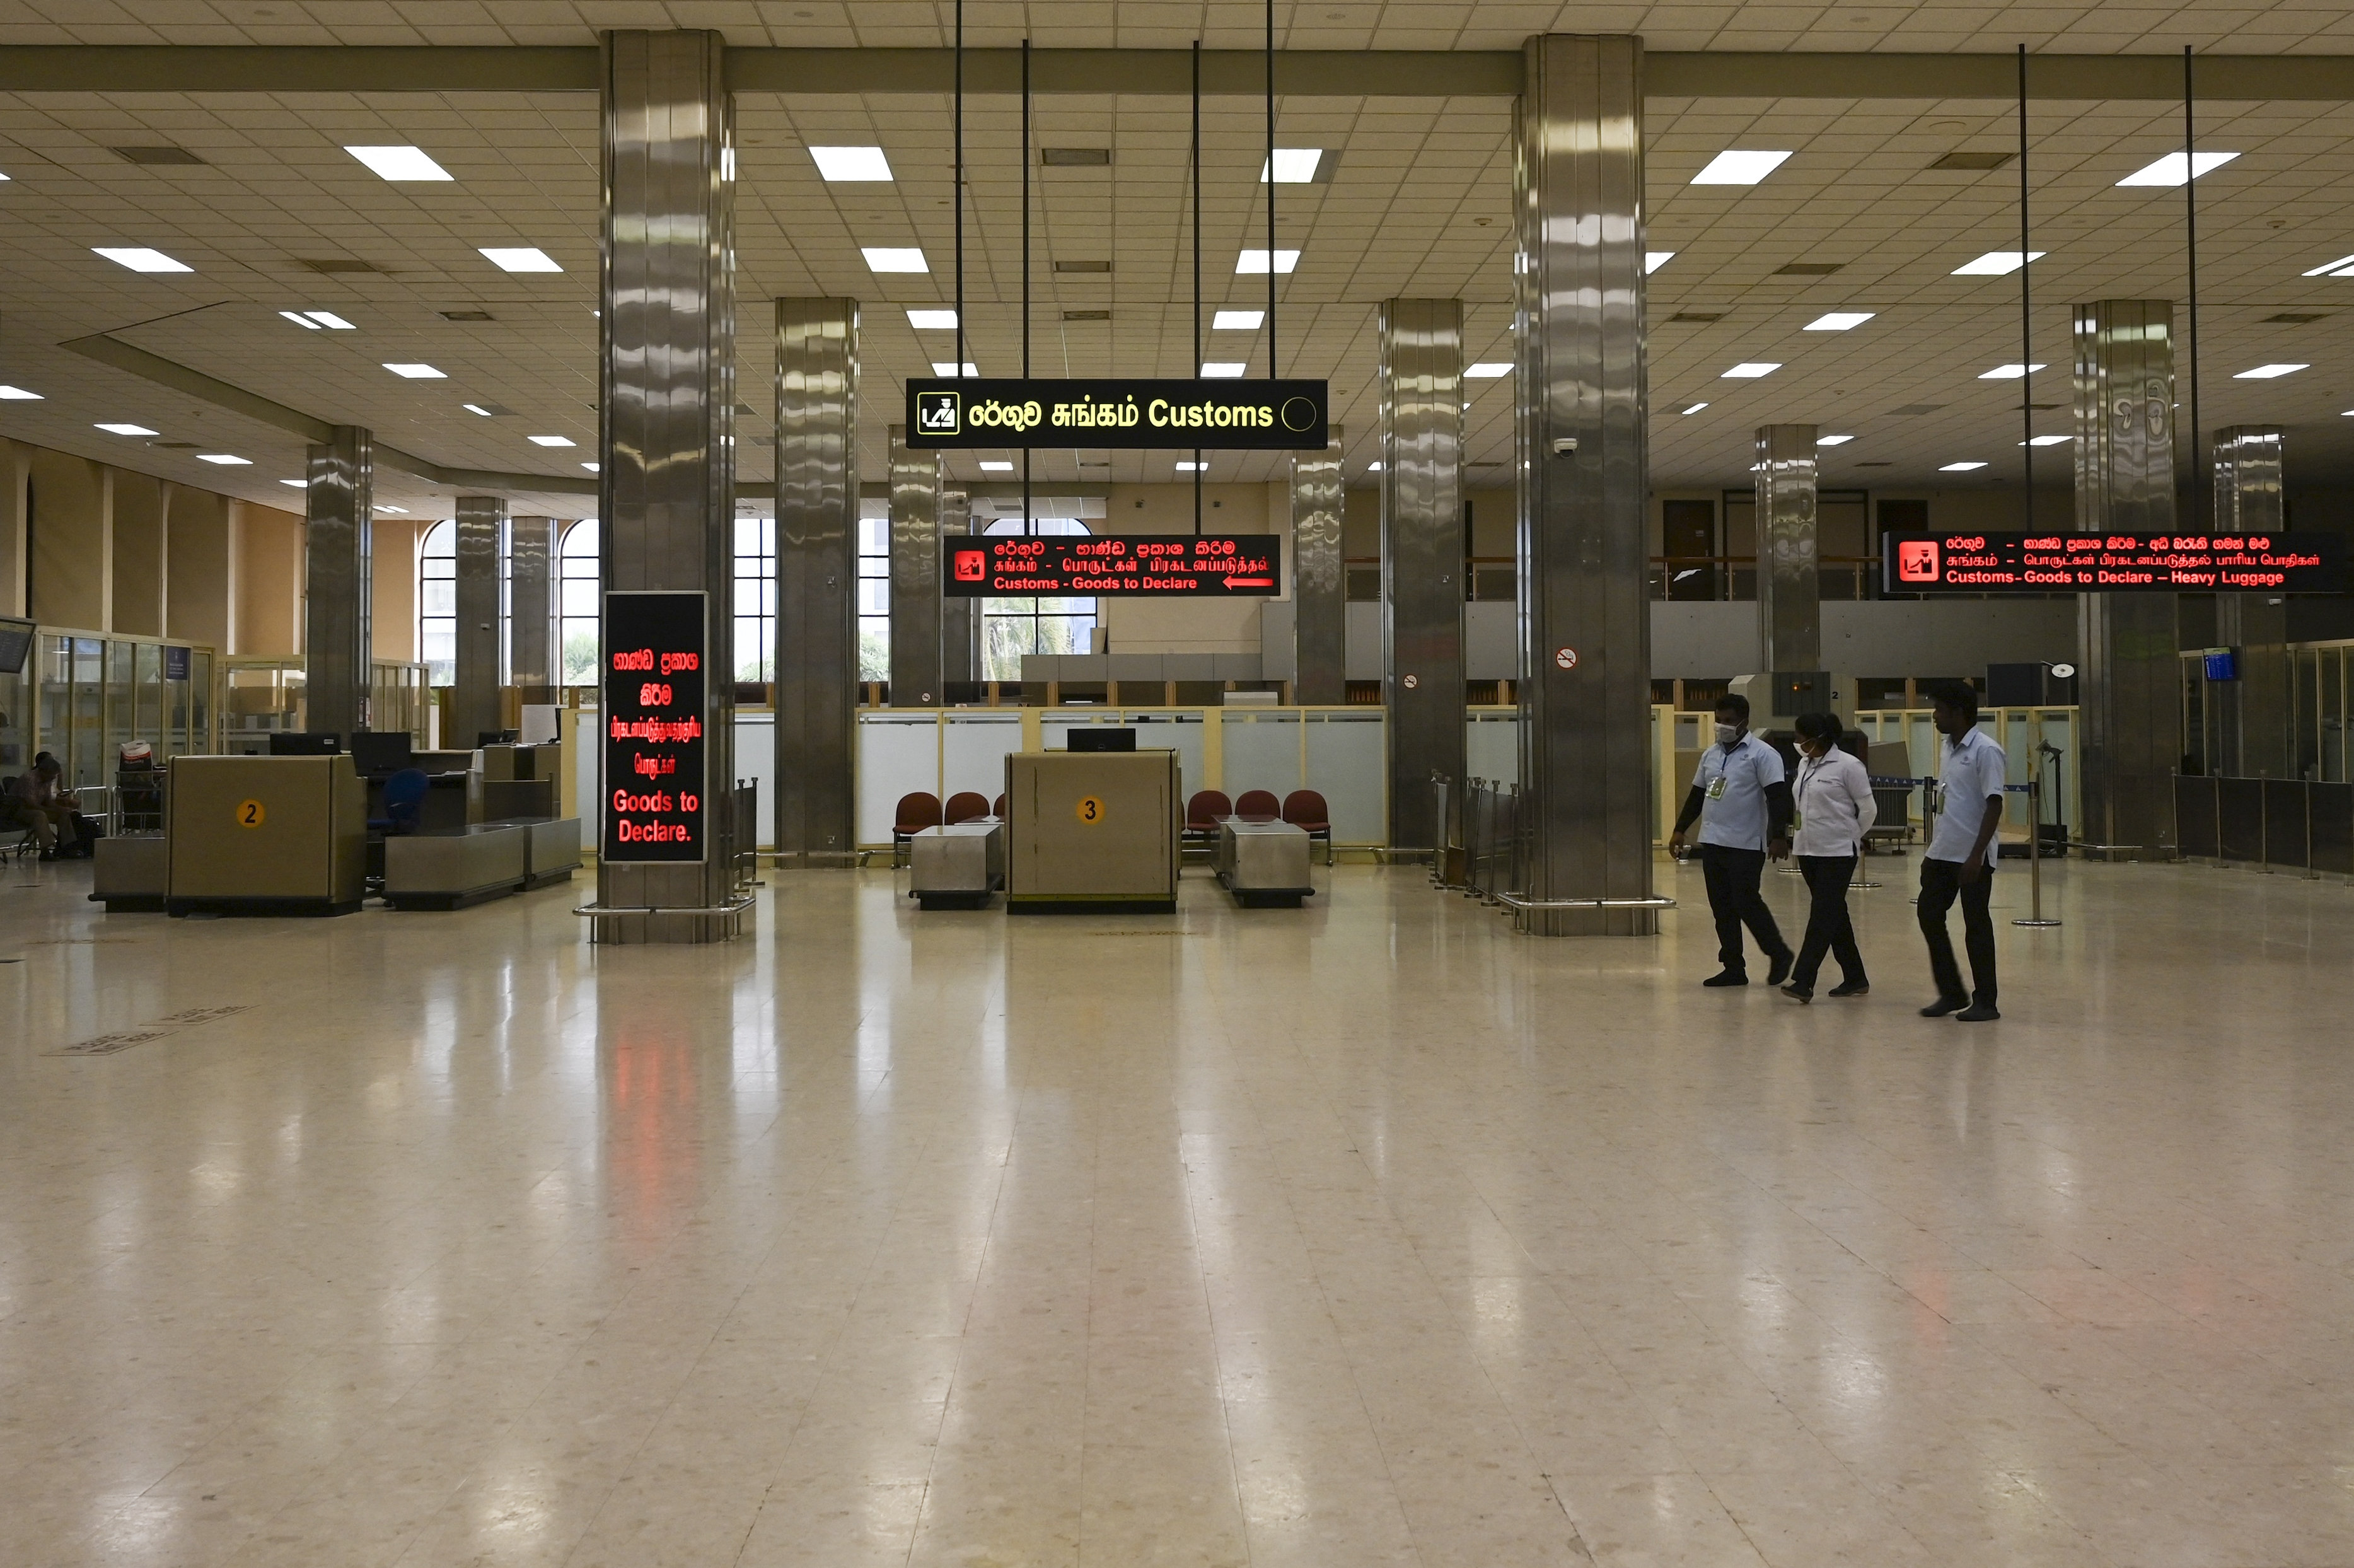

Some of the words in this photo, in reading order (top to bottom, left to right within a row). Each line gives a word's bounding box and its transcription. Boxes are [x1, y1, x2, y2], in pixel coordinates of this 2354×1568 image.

[969, 399, 1042, 432] රේගුව
[1051, 394, 1139, 427] சுங்கம்
[1149, 399, 1273, 427] Customs
[994, 557, 1038, 572] சுங்கம்
[1062, 557, 1139, 575] பொருட்கள்
[1946, 552, 1998, 567] சுங்கம்
[2024, 553, 2096, 569] பொருட்கள்
[2099, 552, 2212, 569] பிரகடனப்படுத்தல்
[2216, 552, 2257, 566] பாரிய
[2260, 553, 2320, 569] பொதிகள்
[994, 576, 1060, 590] Customs
[1072, 576, 1120, 589] Goods
[1123, 577, 1140, 589] to
[1142, 576, 1198, 589] Declare
[2077, 571, 2094, 583] to
[2098, 570, 2153, 584] Declare
[2171, 570, 2217, 586] Heavy
[2222, 571, 2285, 587] Luggage
[1831, 691, 1839, 700] 2
[634, 752, 676, 781] பொருட்கள்
[613, 789, 673, 813] Goods
[680, 791, 699, 812] to
[1085, 800, 1096, 820] 3
[245, 804, 257, 823] 2
[618, 819, 692, 843] Declare.
